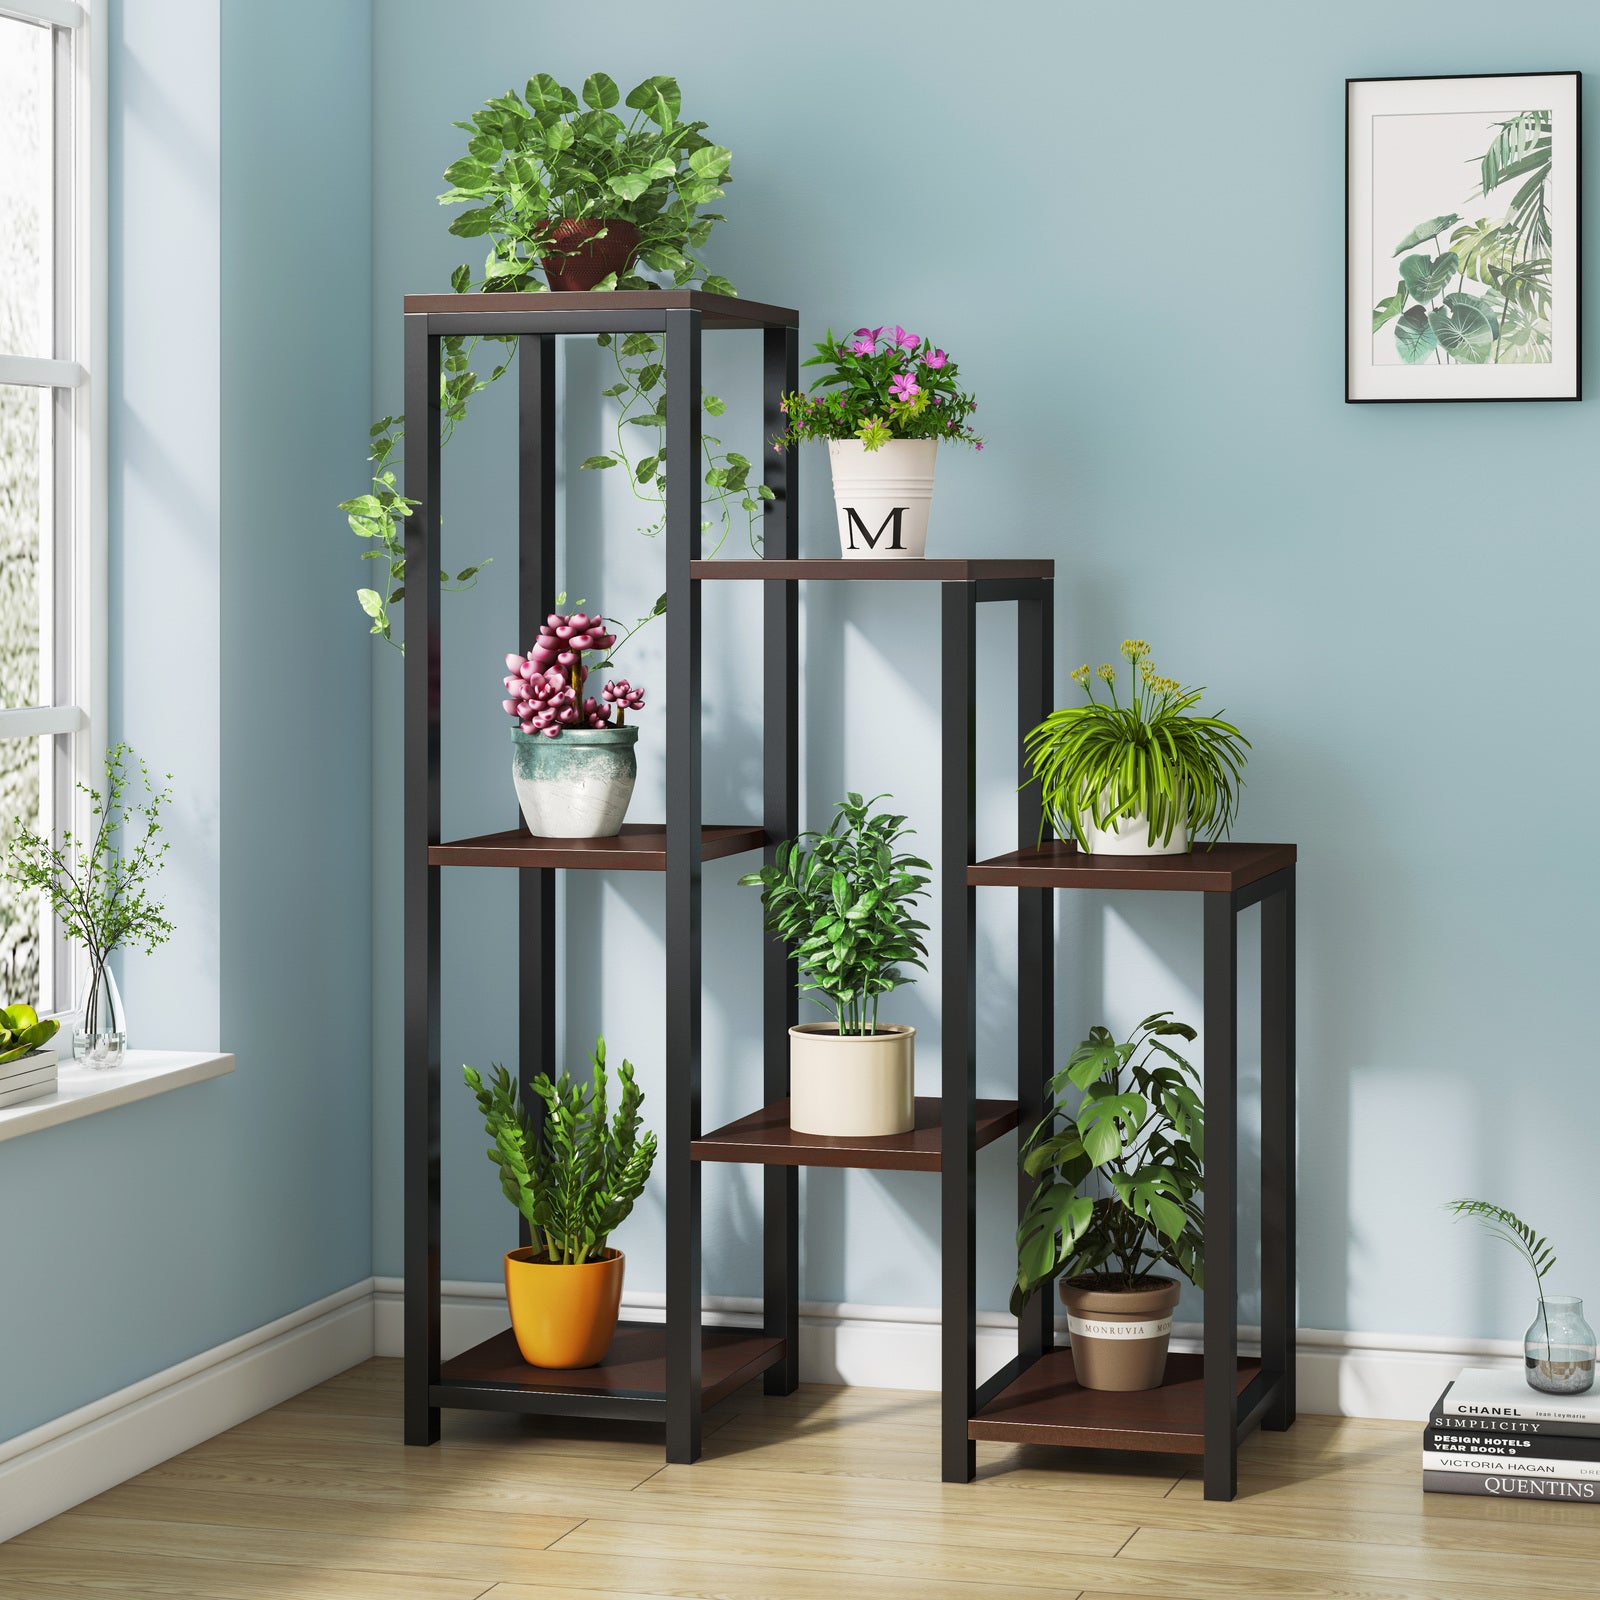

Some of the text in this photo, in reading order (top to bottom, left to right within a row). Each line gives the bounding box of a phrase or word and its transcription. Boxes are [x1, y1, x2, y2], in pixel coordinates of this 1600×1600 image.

[842, 507, 910, 550] M
[1085, 1324, 1144, 1335] MONRUVIA
[1458, 1405, 1521, 1417] CHANEL
[1435, 1418, 1540, 1432] SIMPLICITY
[1434, 1435, 1531, 1448] DESIGN HOTELS
[1434, 1444, 1466, 1452] YEAR
[1470, 1445, 1505, 1454] BOOK
[1440, 1458, 1555, 1473] VICTORIA HAGAN
[1484, 1477, 1594, 1498] QUENTINS
